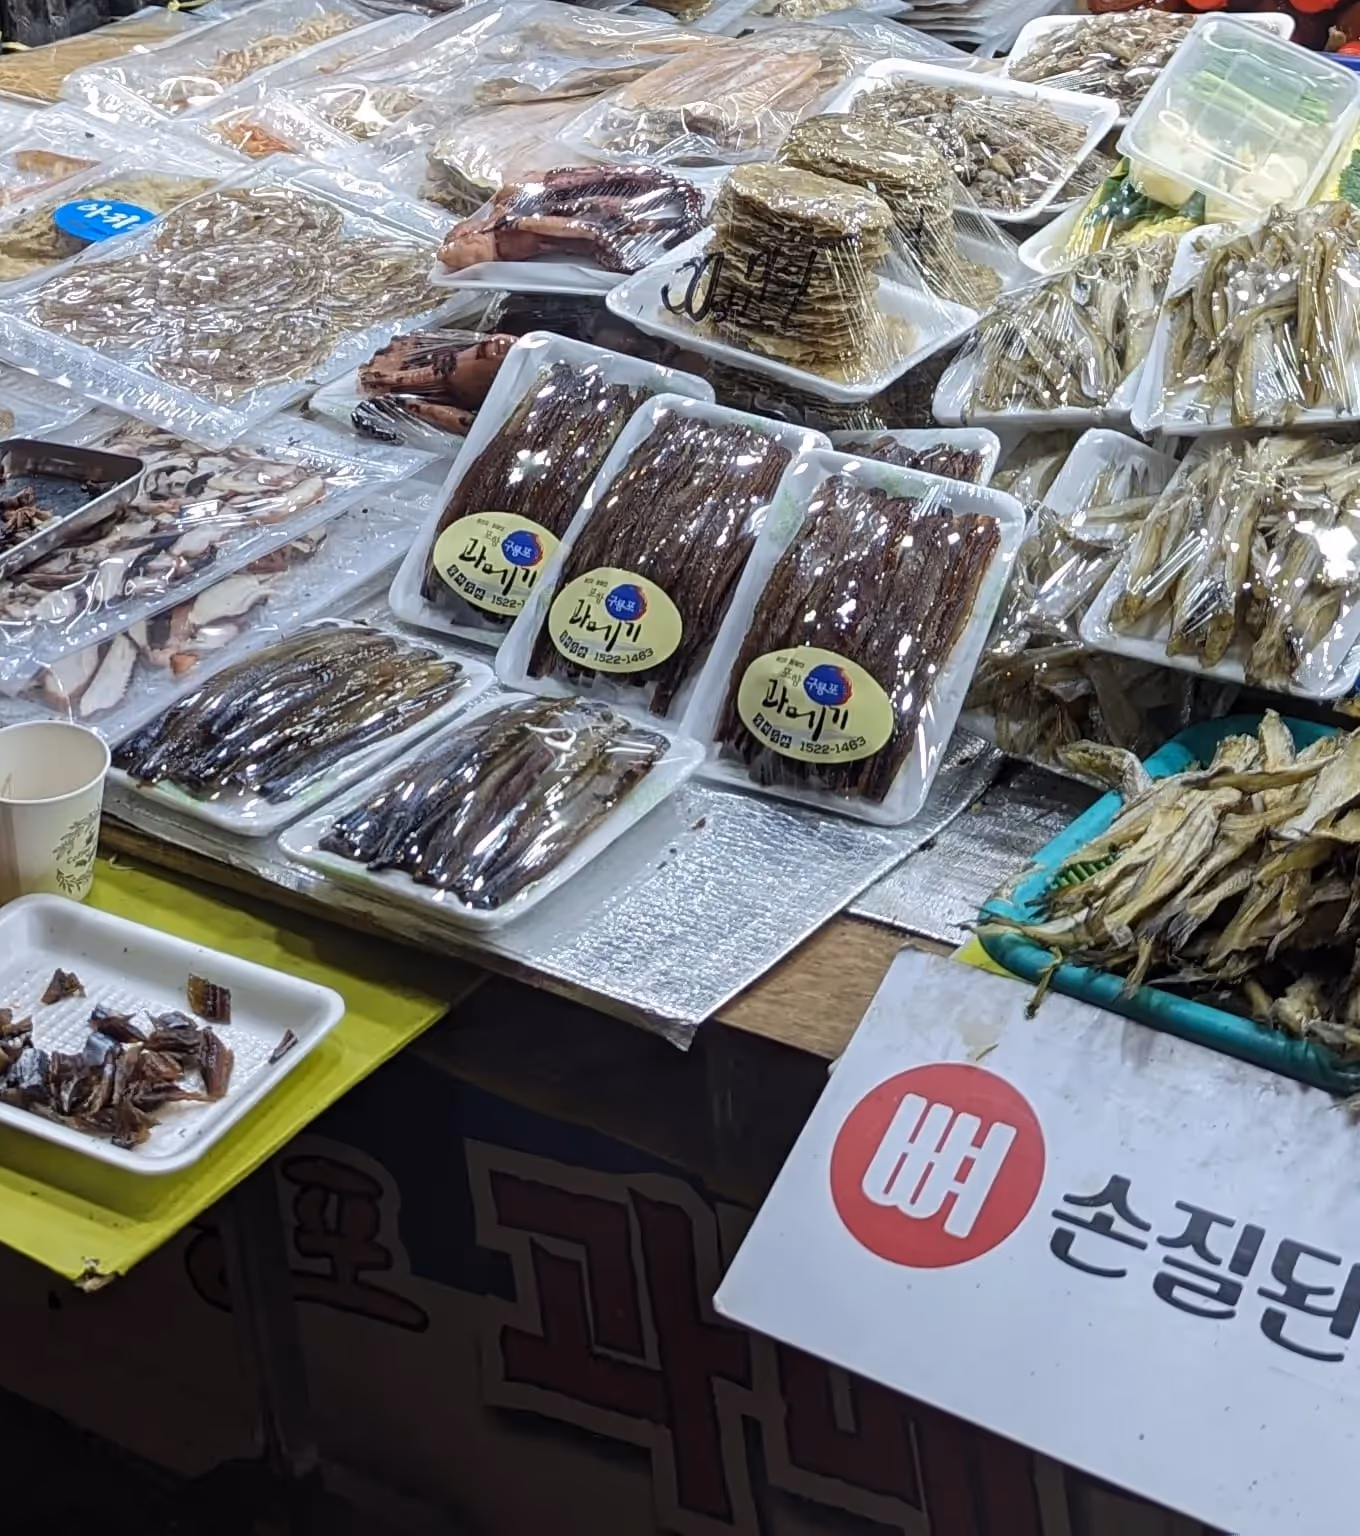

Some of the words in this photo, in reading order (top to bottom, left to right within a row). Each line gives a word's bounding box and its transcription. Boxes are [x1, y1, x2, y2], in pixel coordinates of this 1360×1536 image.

[76, 203, 141, 230] 아귀
[458, 537, 538, 596] 과메기
[490, 594, 526, 610] 1522-1
[568, 598, 642, 653] 과메기
[761, 678, 849, 743] 과메기
